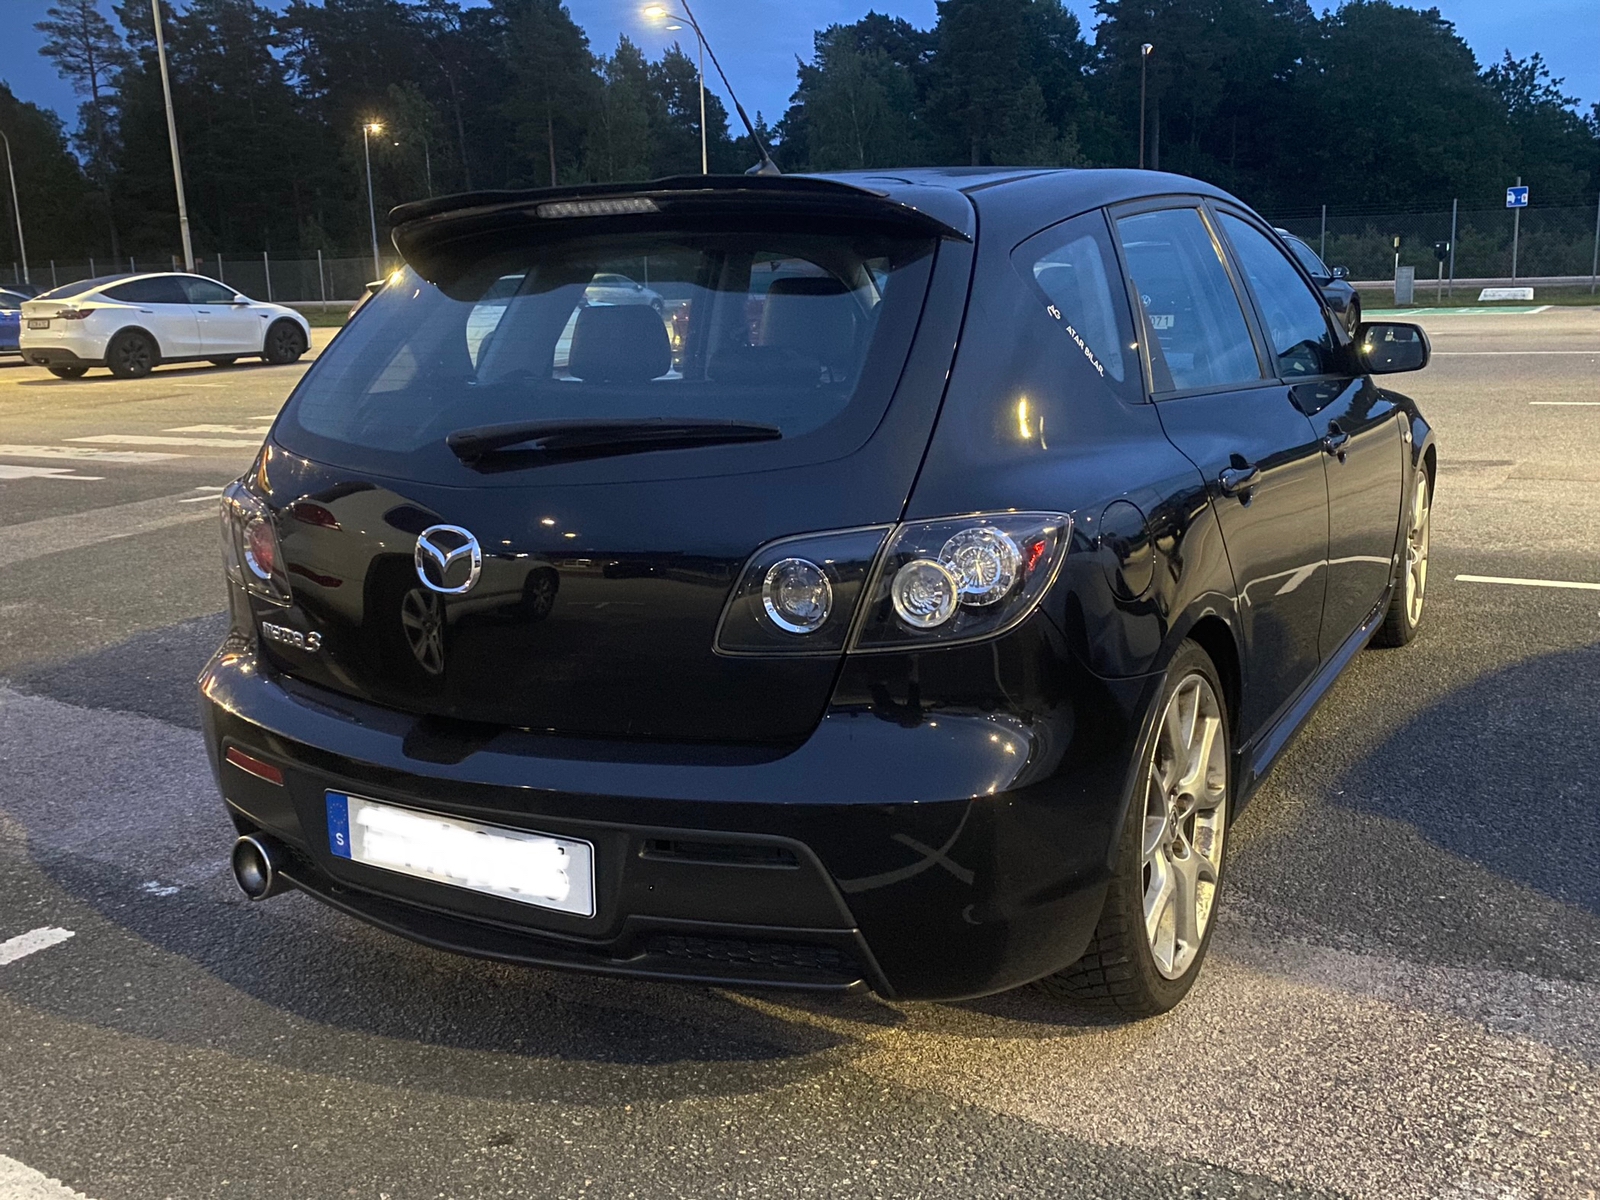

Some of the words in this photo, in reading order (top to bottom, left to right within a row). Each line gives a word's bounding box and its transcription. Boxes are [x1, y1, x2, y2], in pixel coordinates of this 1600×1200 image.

[1065, 325, 1085, 350] ATAR
[1084, 346, 1104, 378] BILAR
[336, 832, 345, 846] S
